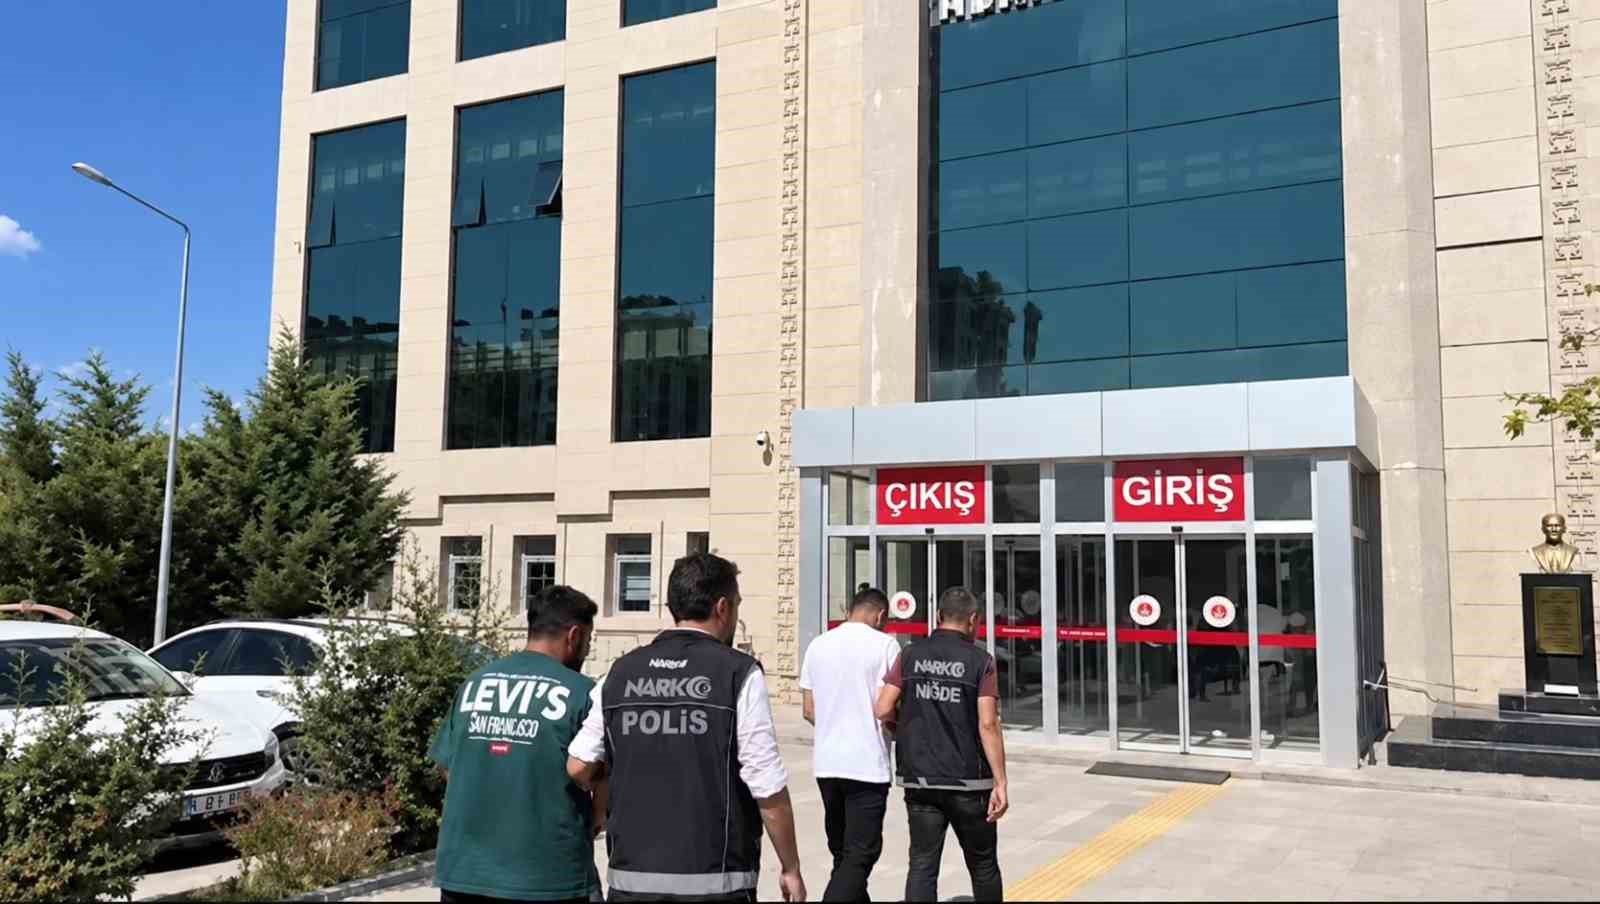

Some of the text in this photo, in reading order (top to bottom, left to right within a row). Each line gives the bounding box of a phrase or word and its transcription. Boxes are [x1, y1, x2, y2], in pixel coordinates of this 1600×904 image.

[885, 481, 976, 517] ÇIKIŞ
[1121, 469, 1235, 512] GİRİŞ
[460, 679, 571, 720] LEVI'S
[468, 712, 540, 739] SAN FRANCISCO
